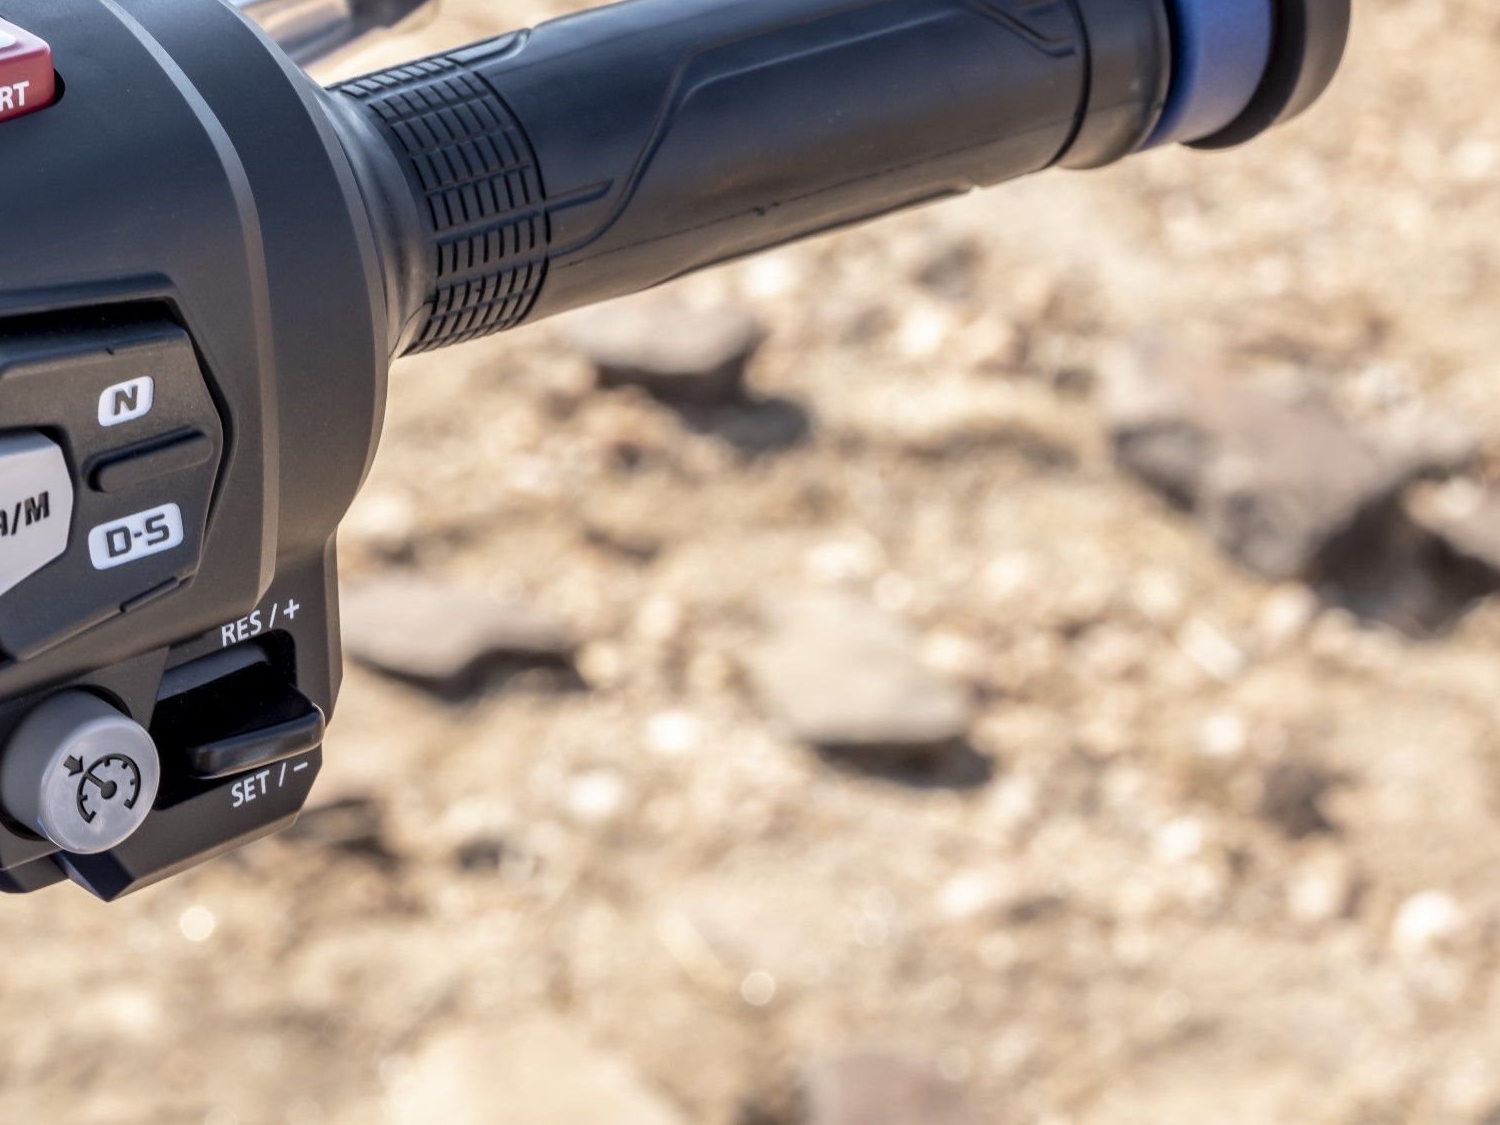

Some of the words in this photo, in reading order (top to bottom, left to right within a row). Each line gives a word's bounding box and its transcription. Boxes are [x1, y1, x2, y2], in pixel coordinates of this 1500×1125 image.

[113, 384, 138, 416] N
[106, 514, 170, 558] D-S
[221, 610, 262, 647] RES
[231, 770, 270, 808] SET
